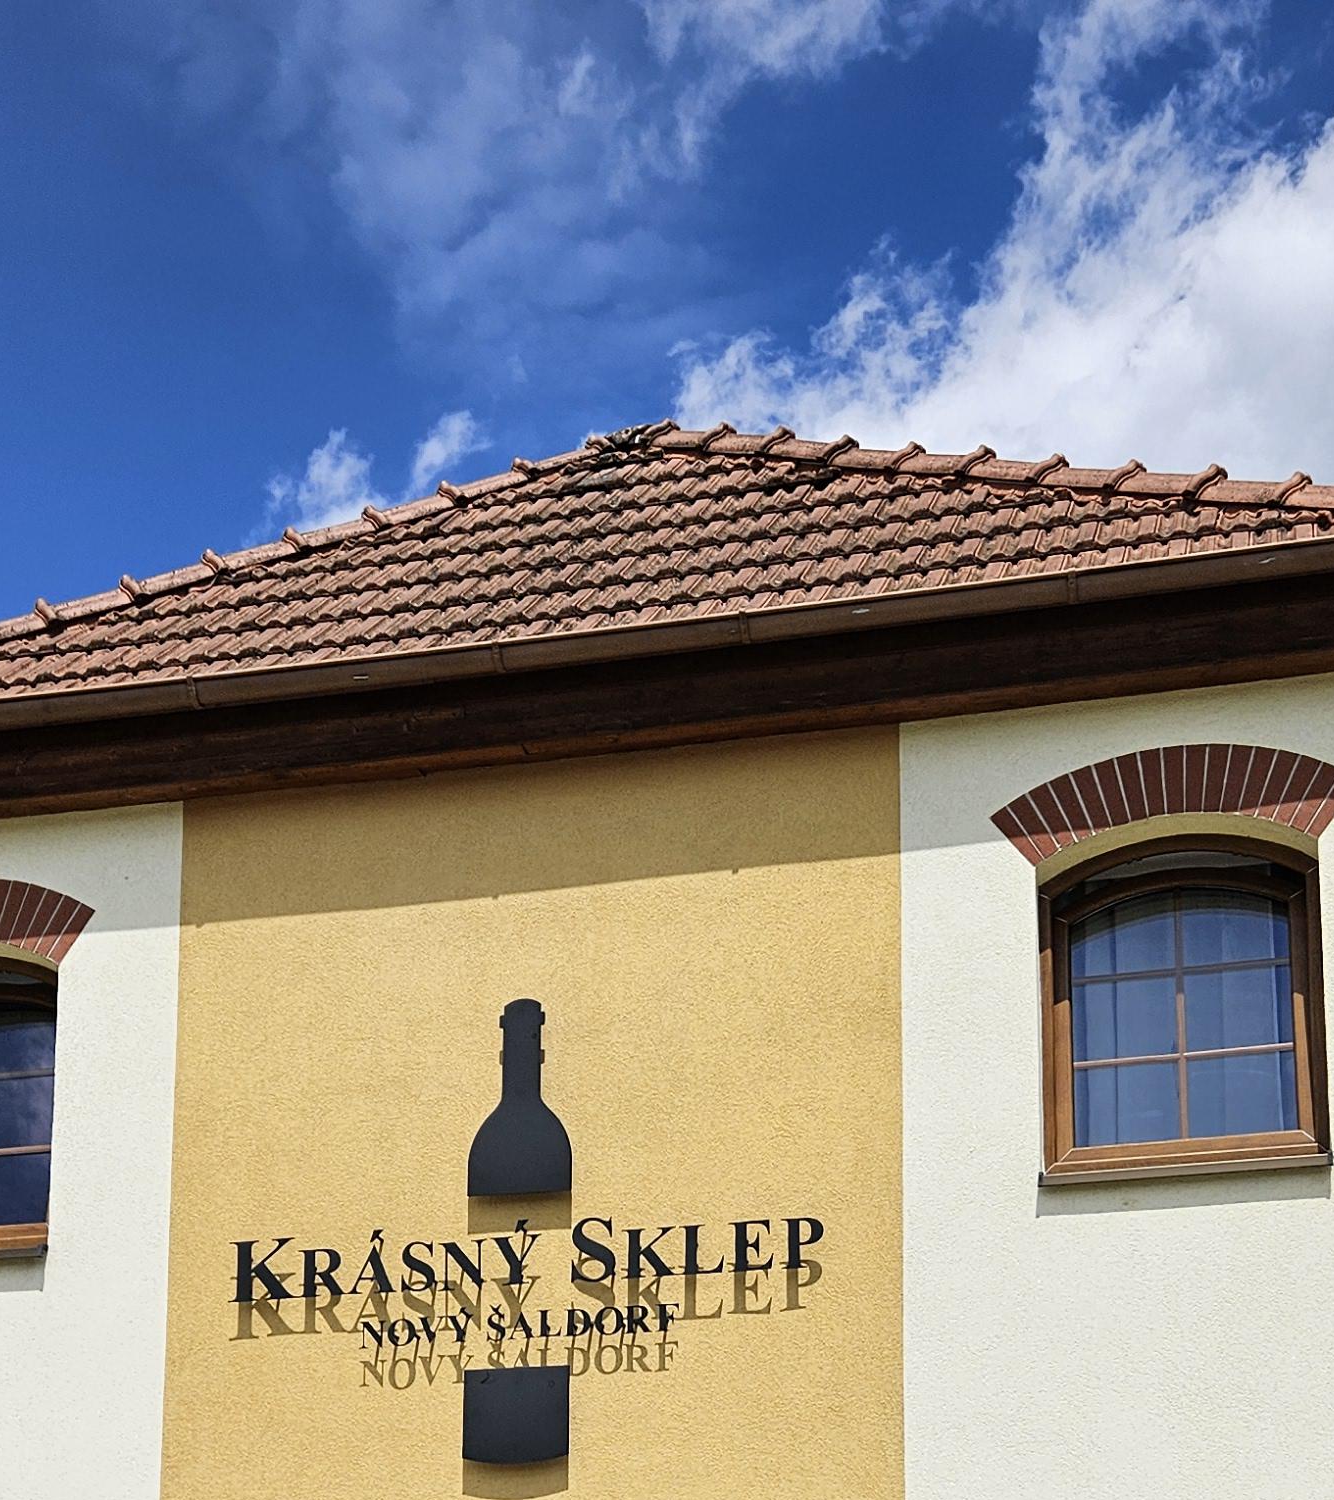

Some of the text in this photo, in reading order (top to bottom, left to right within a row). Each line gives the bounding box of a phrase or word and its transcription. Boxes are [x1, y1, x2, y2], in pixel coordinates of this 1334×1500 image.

[228, 1216, 824, 1303] KRÁSNÝ SKLEP
[359, 1303, 680, 1349] NOVÝ ŠALDORF
